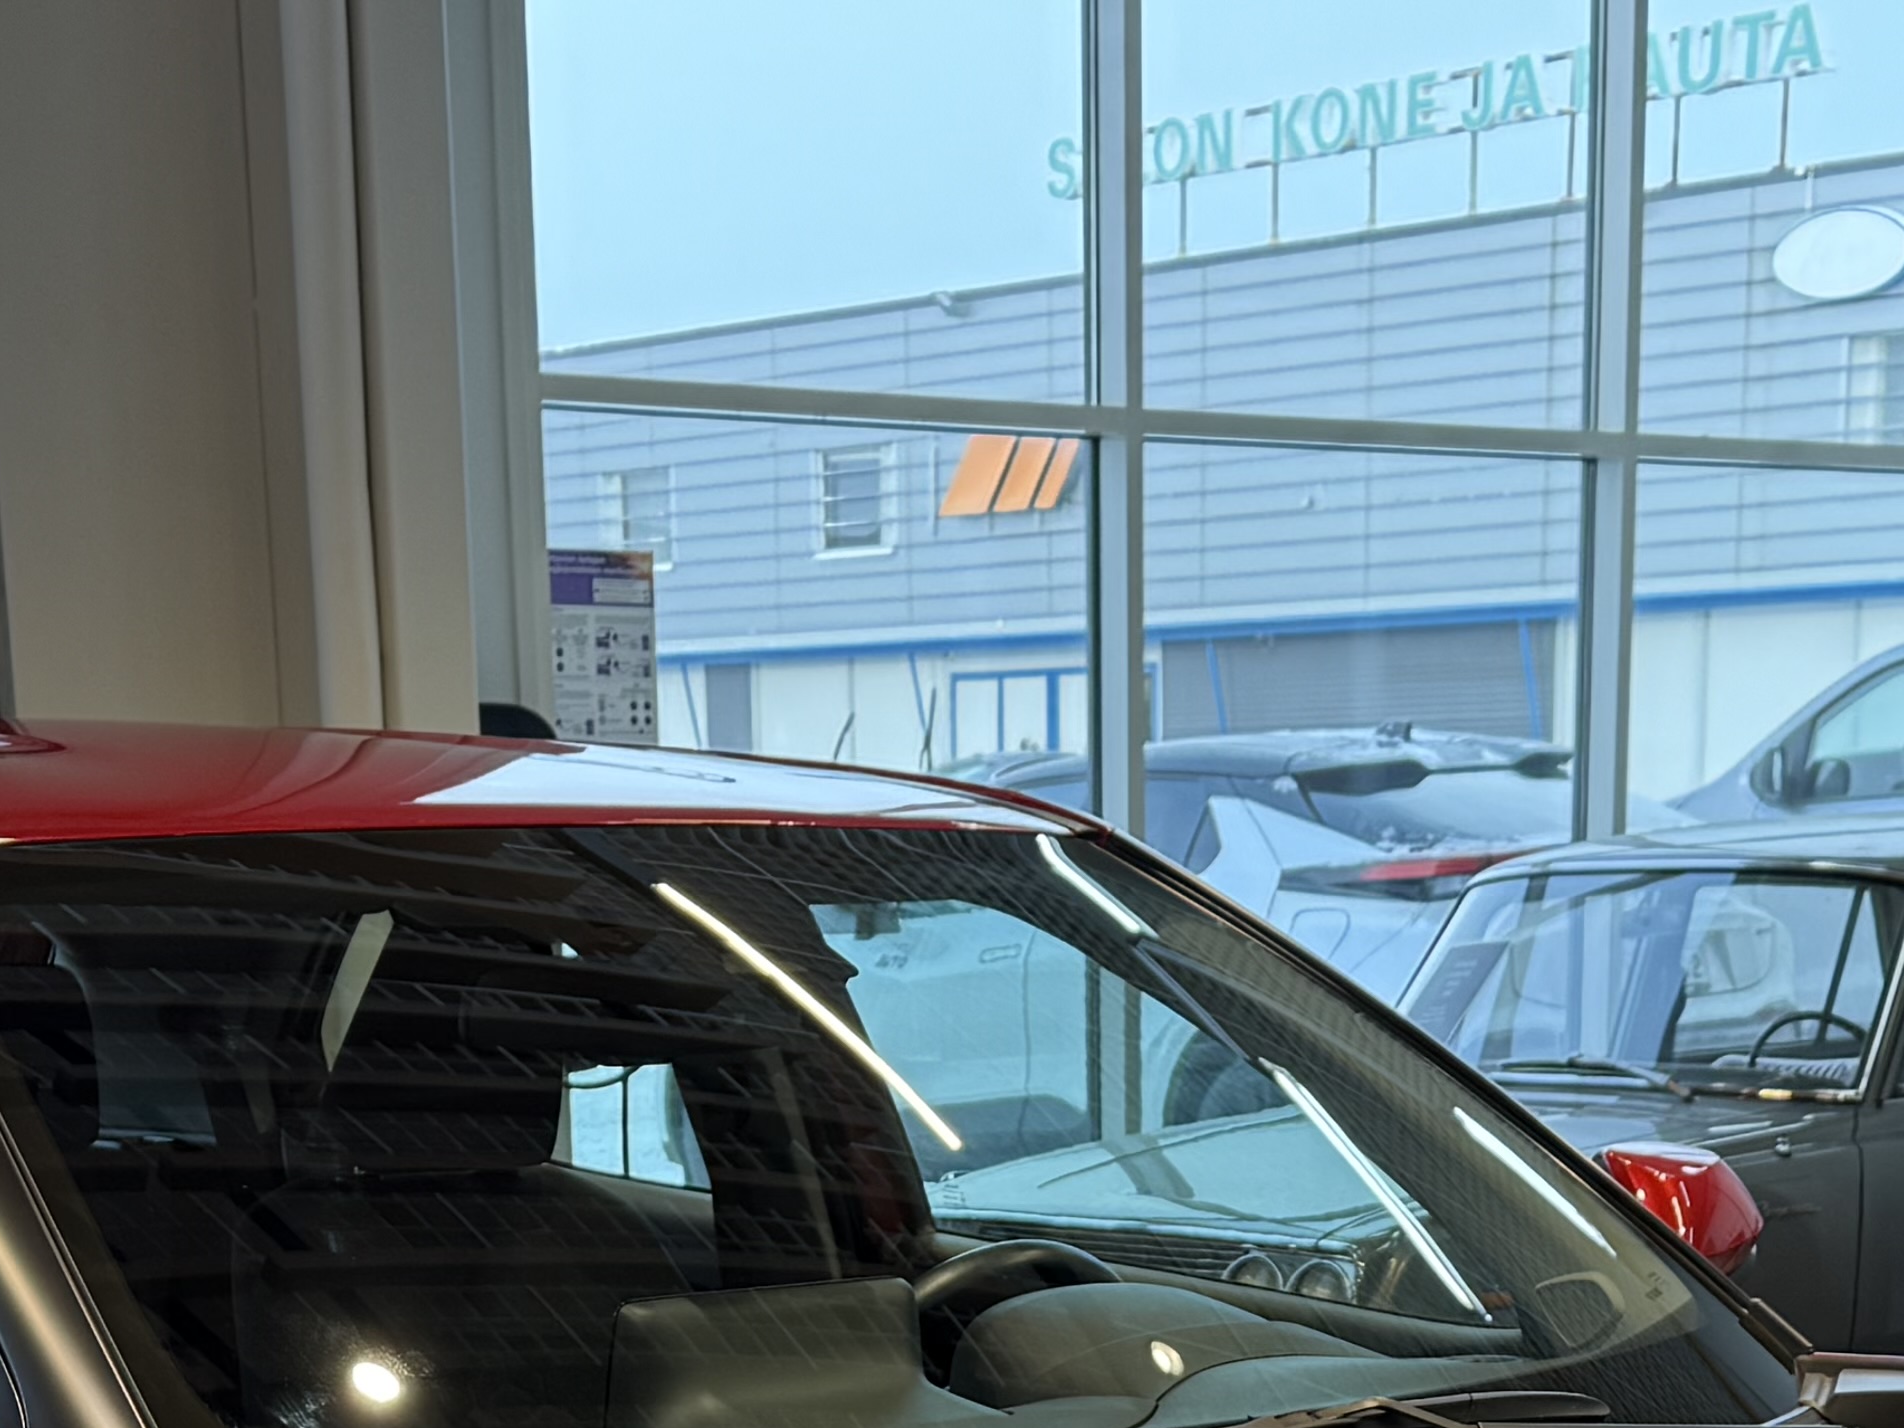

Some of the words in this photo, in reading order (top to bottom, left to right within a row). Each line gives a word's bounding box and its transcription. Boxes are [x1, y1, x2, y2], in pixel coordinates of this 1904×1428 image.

[1047, 107, 1234, 199] SON
[1271, 70, 1438, 164] KONE
[1460, 60, 1546, 131] JA
[1573, 2, 1824, 116] AUTA
